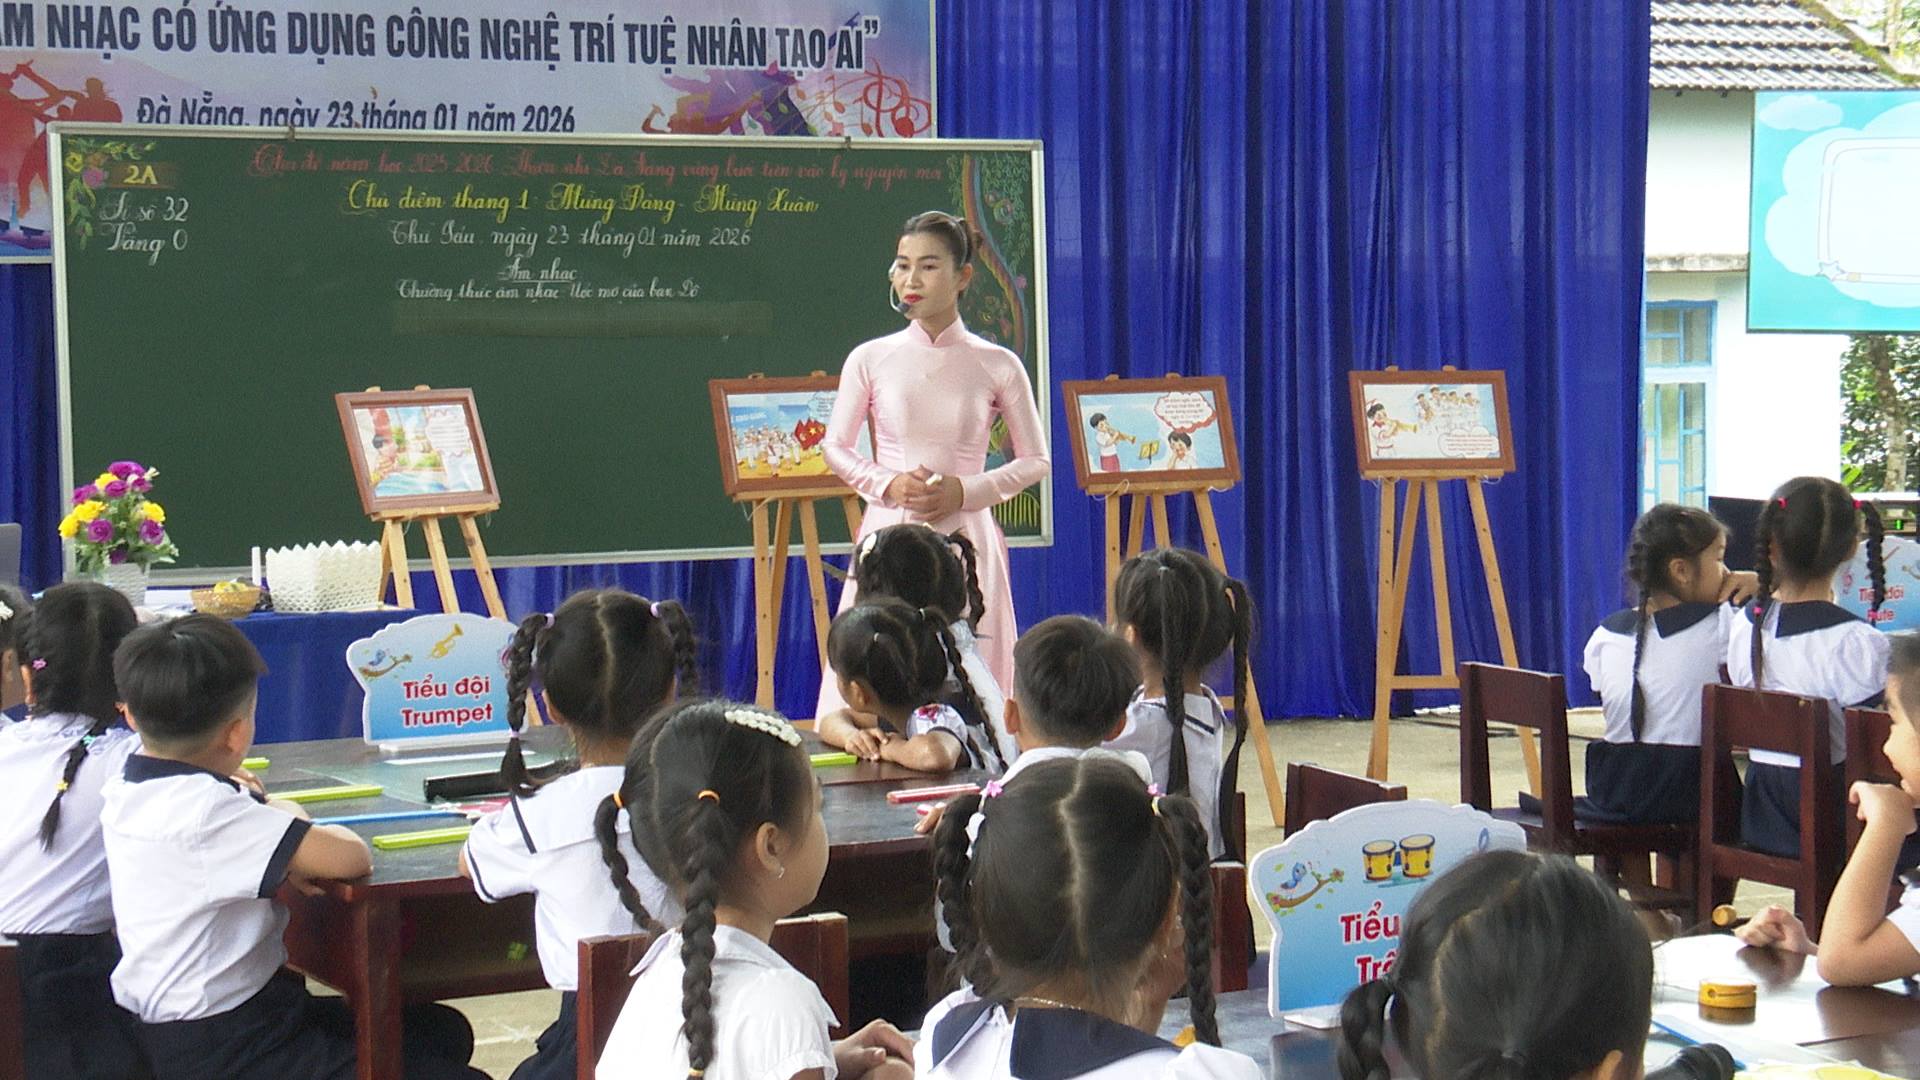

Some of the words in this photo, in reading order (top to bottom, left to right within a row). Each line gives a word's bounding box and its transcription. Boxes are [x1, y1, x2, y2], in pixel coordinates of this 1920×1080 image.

[0, 3, 34, 47] M
[47, 4, 140, 60] NHẠC
[153, 0, 197, 52] CÓ
[208, 0, 276, 54] ỨNG
[287, 11, 375, 65] DỤNG
[386, 6, 470, 59] CÔNG
[480, 11, 560, 71] NGHỆ
[569, 13, 615, 63] TRÍ
[624, 15, 676, 74] TUỆ
[687, 17, 767, 67] NHÂN
[775, 27, 826, 77] TẠO
[137, 94, 171, 125] Đà
[327, 100, 354, 128] 23
[433, 103, 458, 130] 01
[467, 103, 515, 132] năm
[522, 104, 575, 133] 2026
[123, 165, 158, 185] 2A
[162, 196, 189, 222] 32
[172, 228, 188, 251] 0
[546, 224, 570, 245] 23
[638, 226, 656, 247] 01
[709, 226, 752, 247] 2026
[403, 673, 447, 699] Tiểu
[455, 675, 490, 699] đội
[401, 703, 493, 726] Trumpet
[1340, 901, 1400, 943] Tiểu
